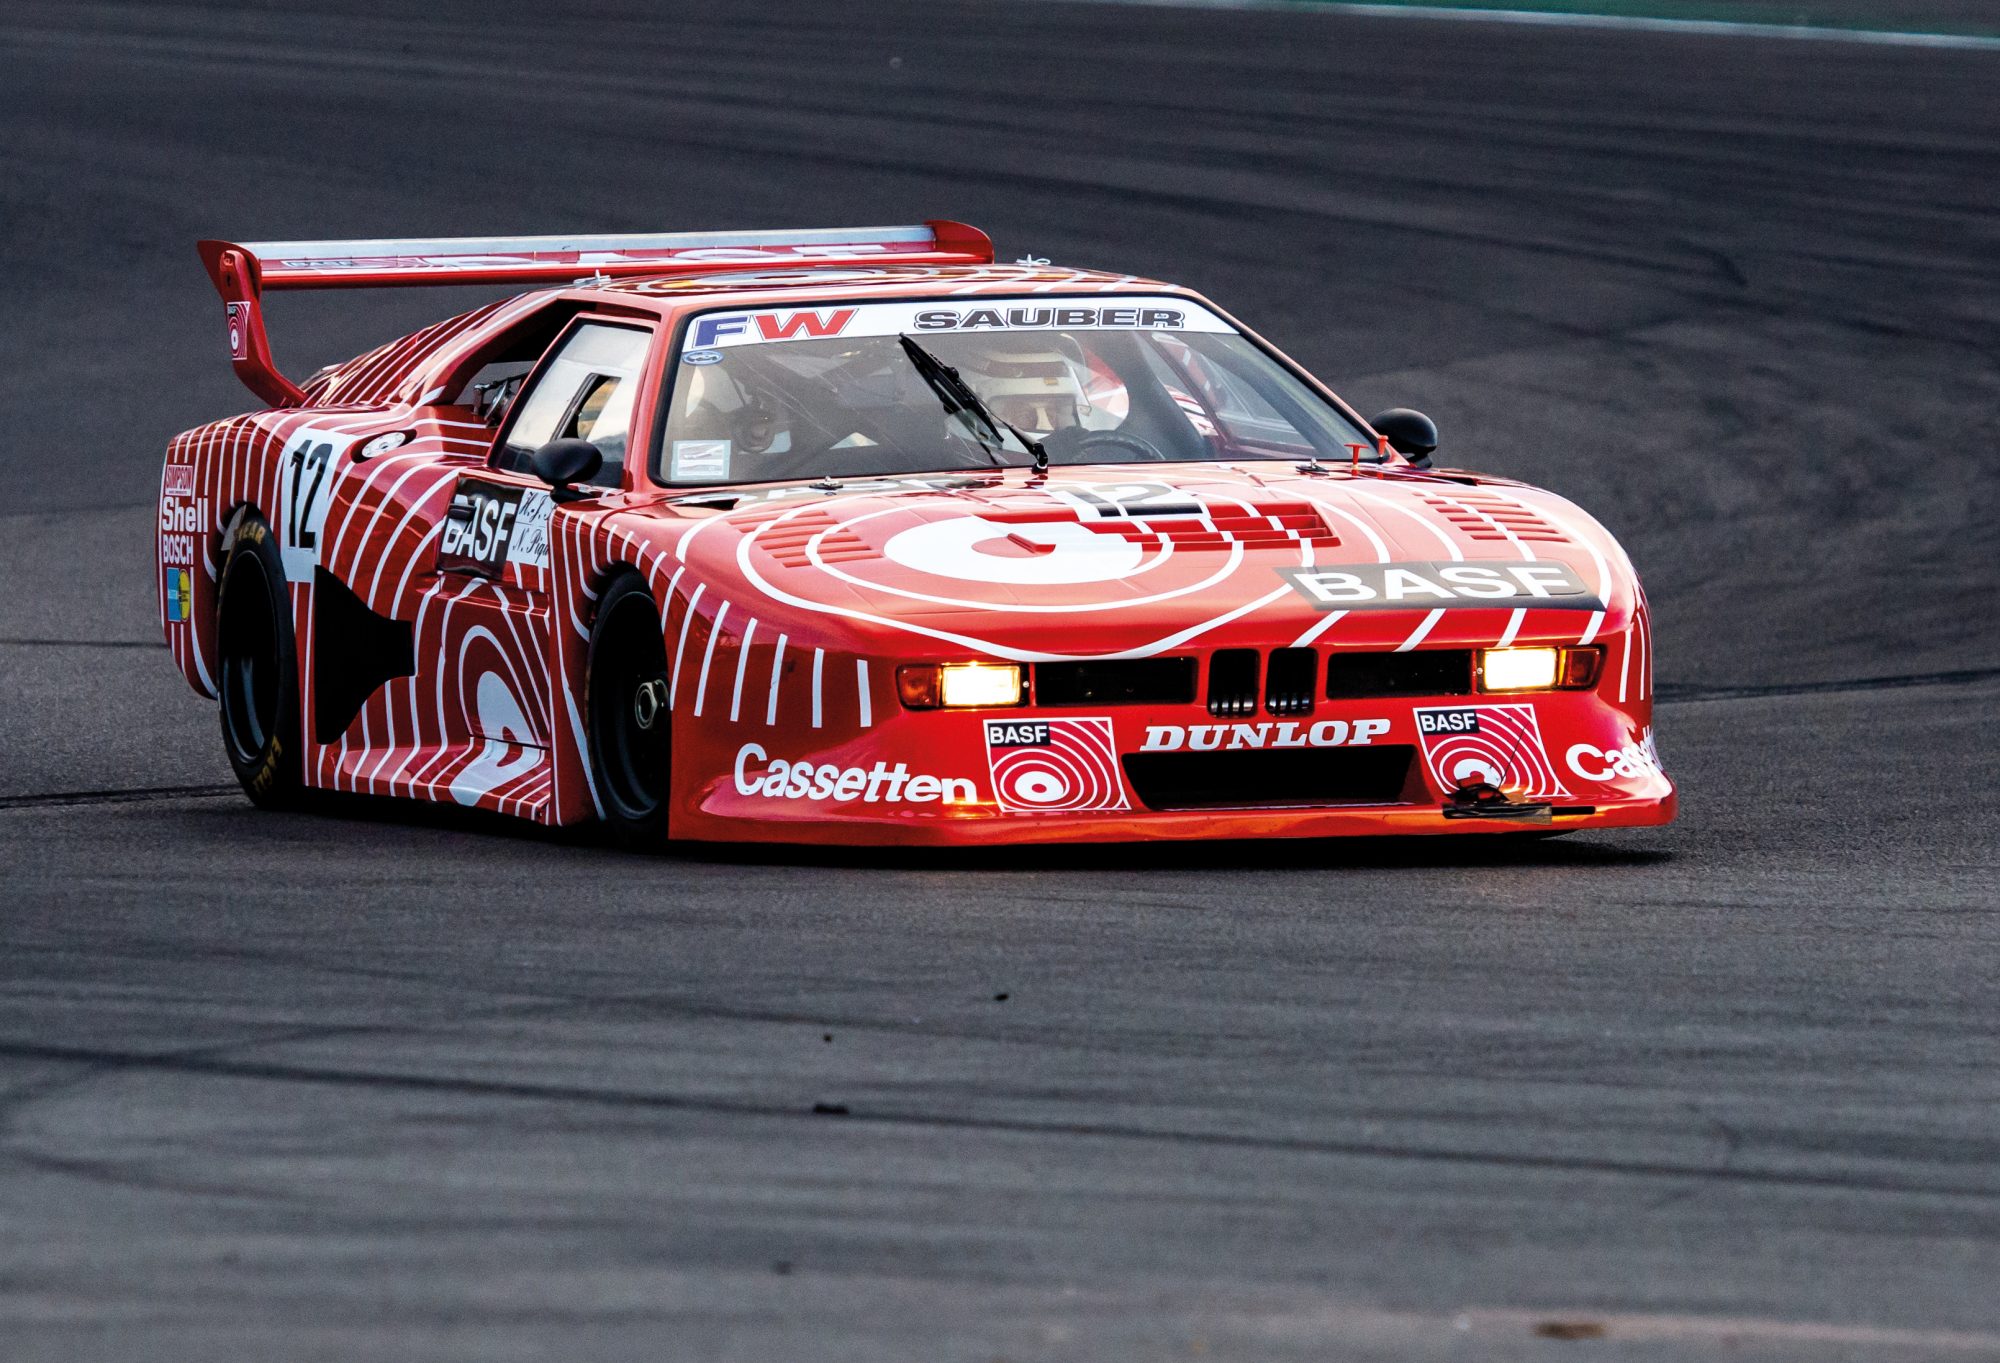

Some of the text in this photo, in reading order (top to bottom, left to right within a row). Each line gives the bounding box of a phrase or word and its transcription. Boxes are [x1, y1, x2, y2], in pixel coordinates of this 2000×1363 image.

[692, 308, 859, 349] FW
[914, 307, 1186, 331] SAUBER
[289, 440, 333, 552] 12
[1053, 483, 1204, 517] 12
[162, 496, 208, 532] Shell
[163, 535, 194, 565] BOSCH
[1295, 565, 1572, 602] BASF
[989, 725, 1048, 744] BASF
[1139, 718, 1391, 752] DUNLOP
[1421, 712, 1477, 733] BASF
[734, 743, 978, 804] Cassetten
